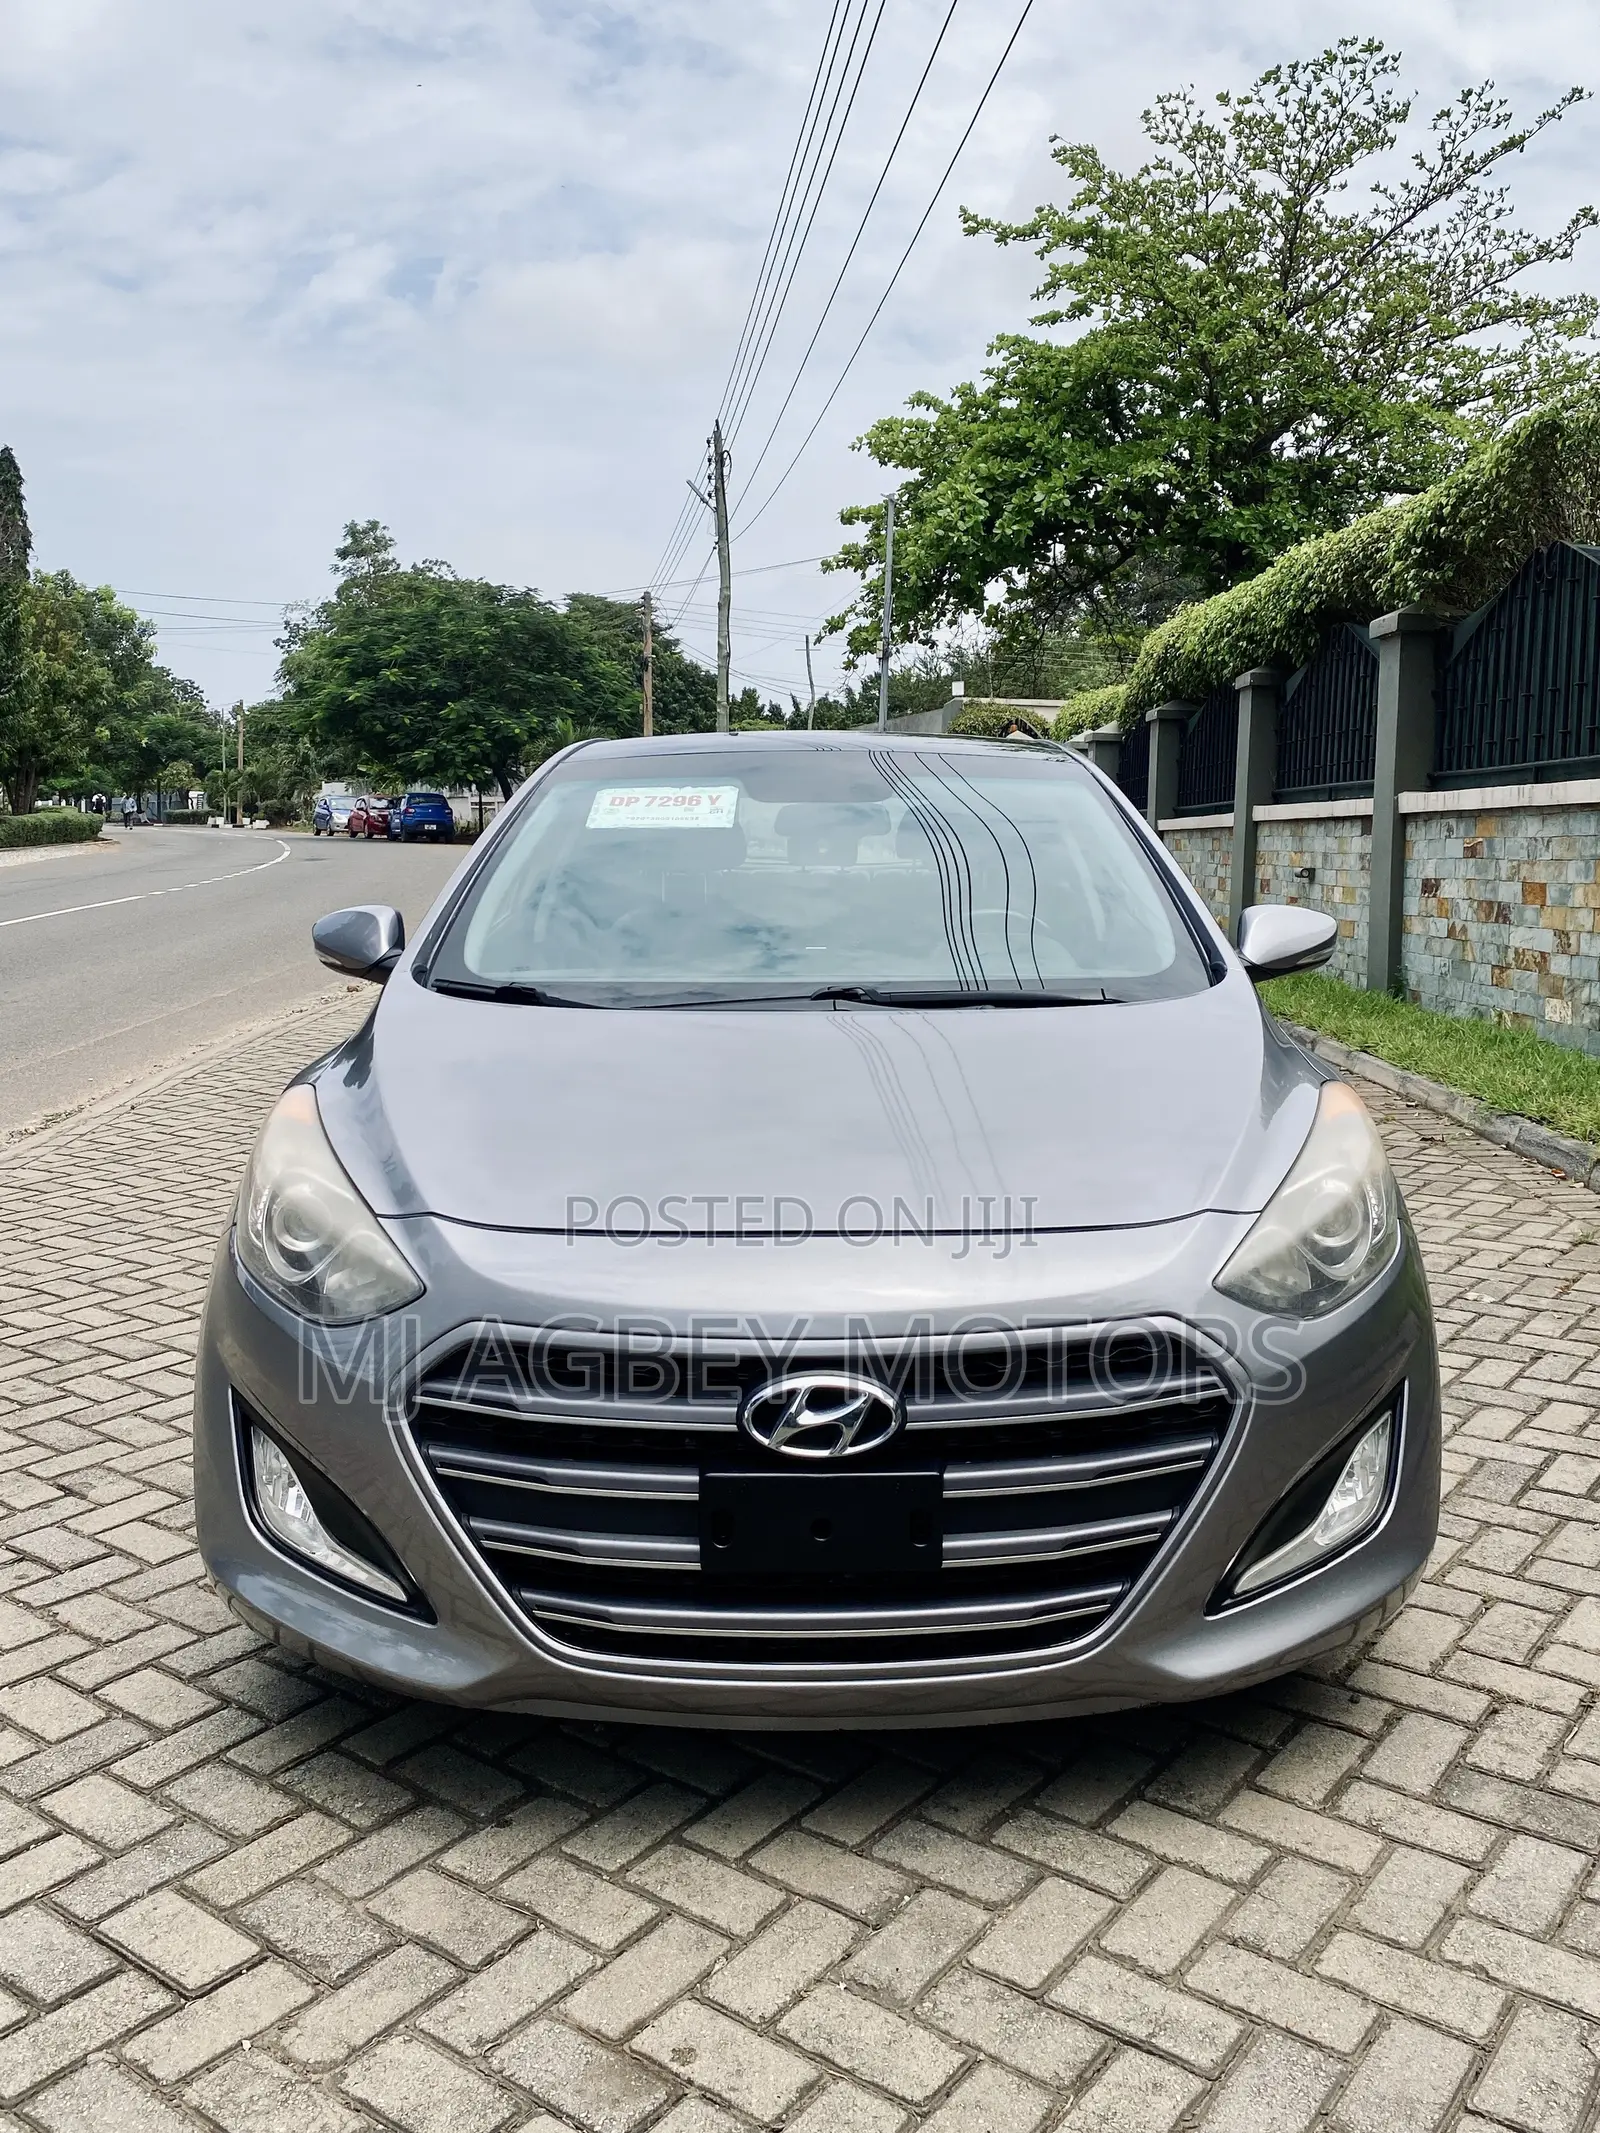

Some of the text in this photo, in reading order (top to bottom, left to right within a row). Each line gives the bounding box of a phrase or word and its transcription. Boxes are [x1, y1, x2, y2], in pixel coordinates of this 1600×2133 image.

[609, 795, 722, 807] DP 7296 Y
